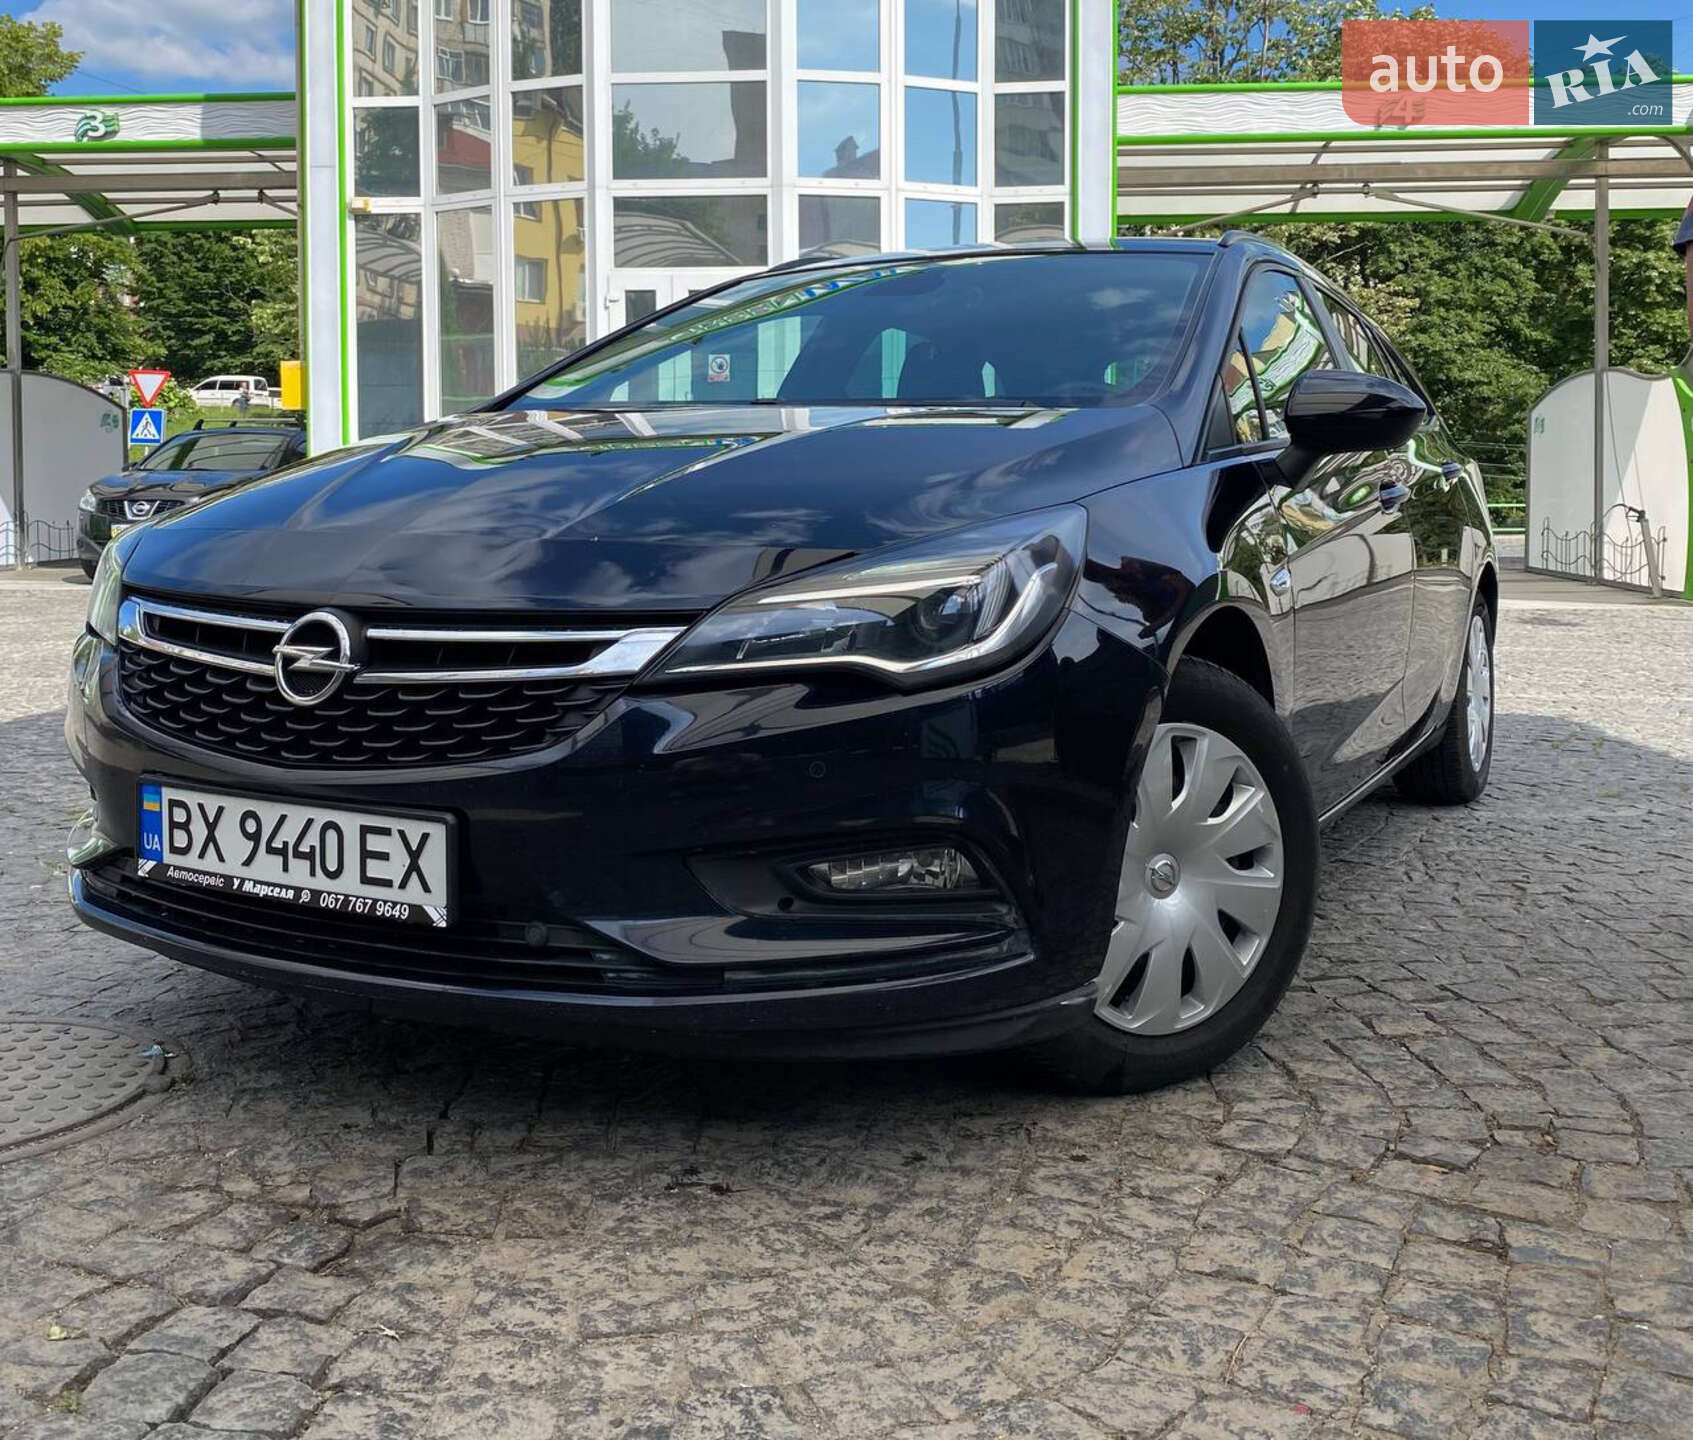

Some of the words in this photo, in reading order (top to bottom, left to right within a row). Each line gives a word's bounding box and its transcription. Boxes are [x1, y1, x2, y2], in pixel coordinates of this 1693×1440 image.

[143, 831, 161, 851] UA
[167, 798, 226, 863] BX
[239, 809, 345, 880] 9440
[359, 824, 432, 894] EX
[242, 879, 295, 900] Марселя
[319, 892, 345, 910] 067
[348, 896, 373, 914] 767
[375, 900, 409, 920] 9649
